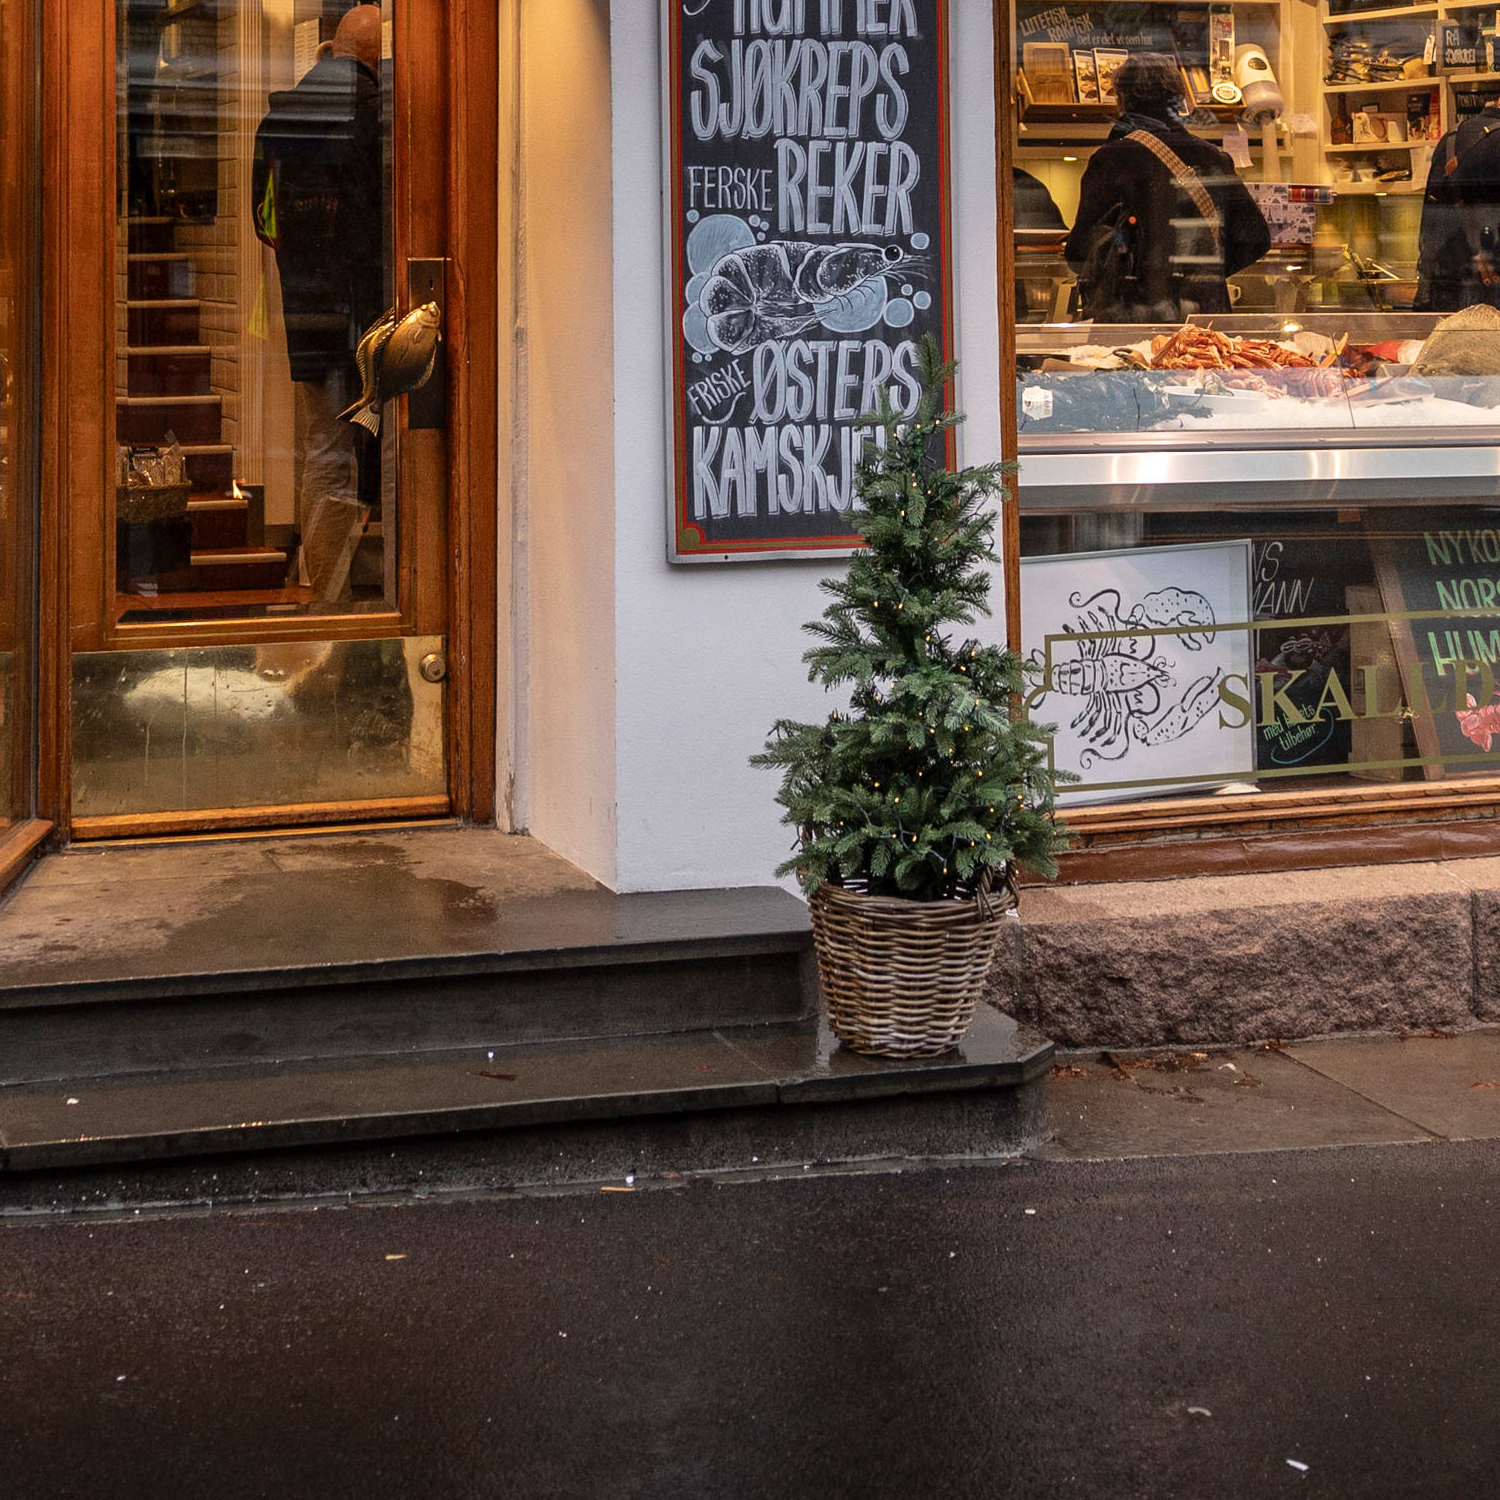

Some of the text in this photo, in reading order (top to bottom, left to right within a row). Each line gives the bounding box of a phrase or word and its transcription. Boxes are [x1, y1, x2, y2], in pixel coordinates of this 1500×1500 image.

[690, 37, 911, 142] SJØKREPS
[687, 137, 921, 236] FERSKE REKER
[687, 338, 922, 426] FRISKE ØSTERS
